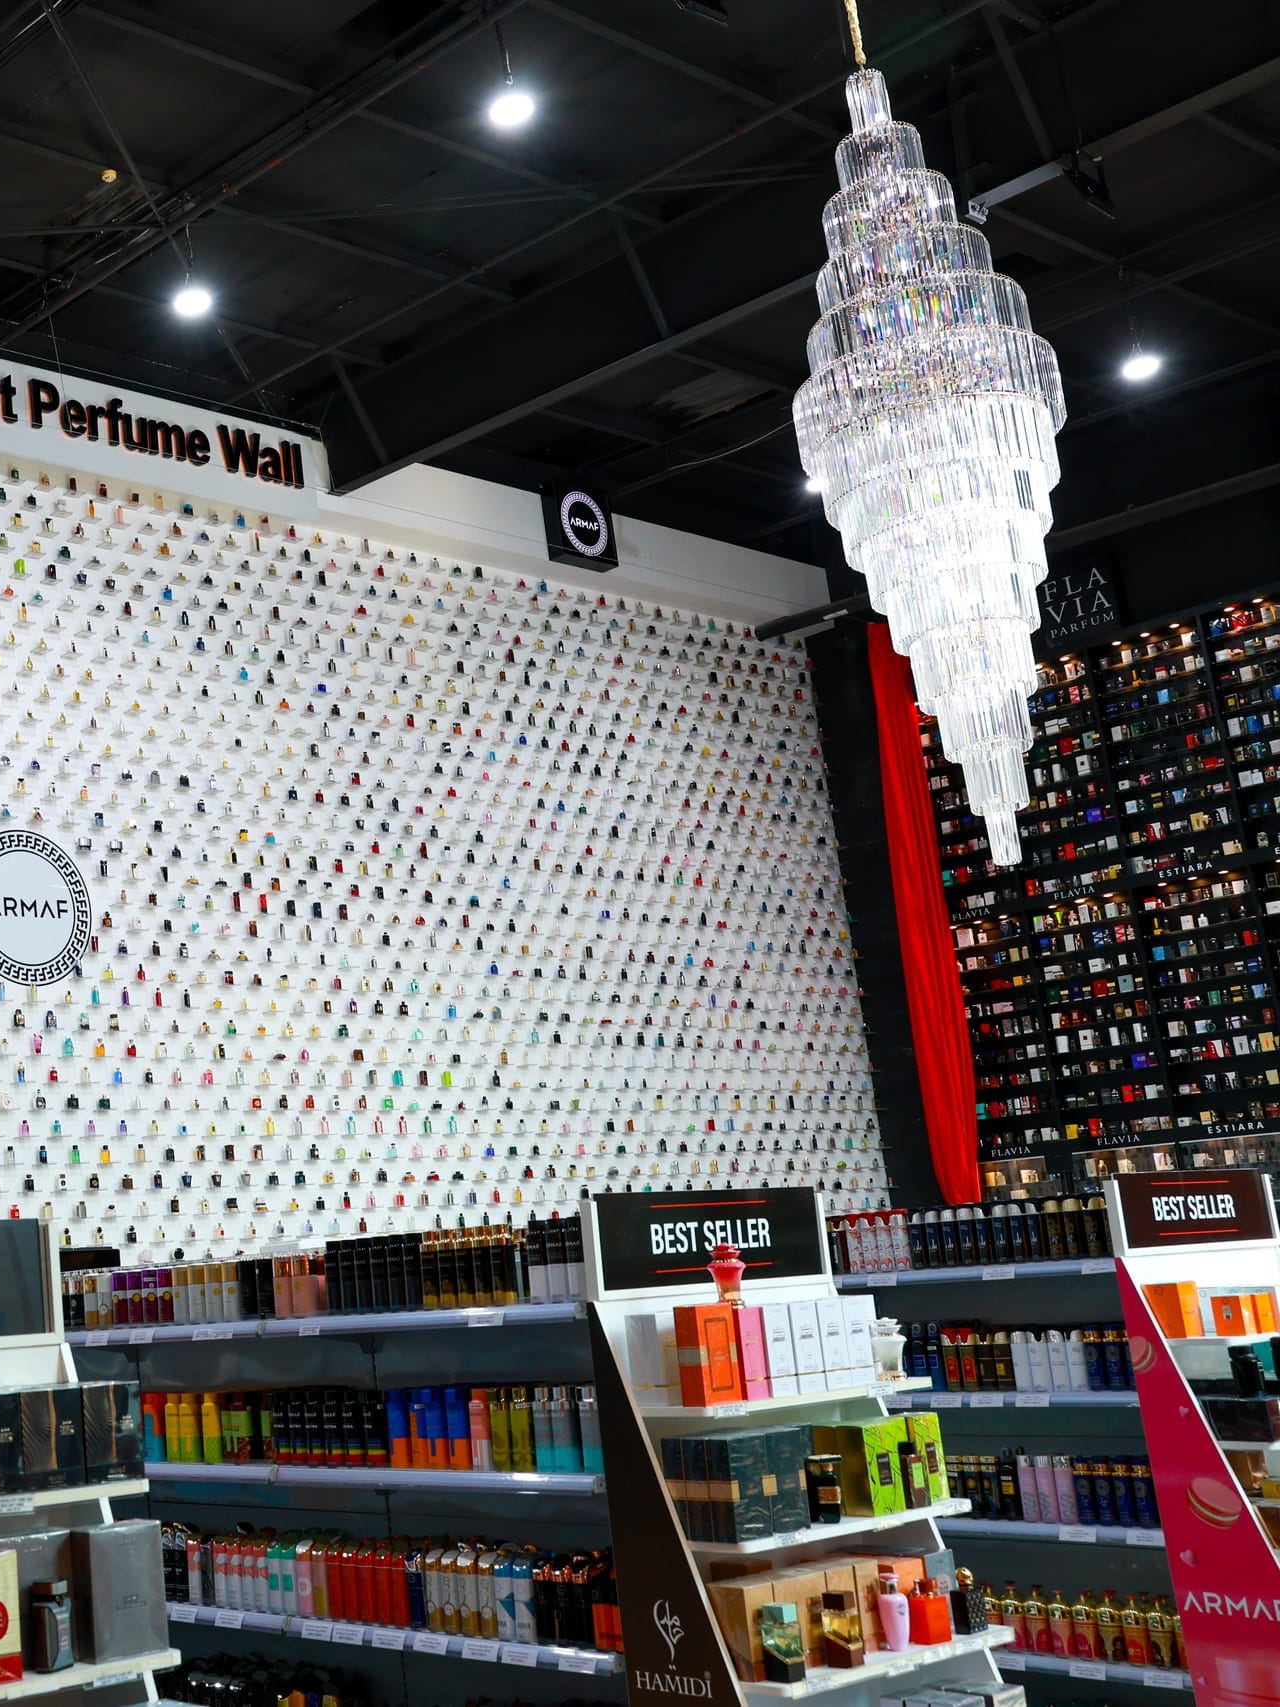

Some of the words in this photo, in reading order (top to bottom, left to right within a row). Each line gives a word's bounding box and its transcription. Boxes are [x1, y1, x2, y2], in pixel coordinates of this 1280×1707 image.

[26, 378, 211, 467] Perfume
[216, 423, 304, 489] Wall
[570, 517, 599, 531] ARMAF
[1041, 567, 1108, 604] FLA
[1045, 590, 1112, 624] VIA
[1050, 611, 1115, 639] PARFUM
[1158, 861, 1213, 879] ESTIARA
[1054, 885, 1096, 901] FLAVIA
[952, 907, 990, 921] FLAVIA
[1207, 1121, 1265, 1134] ESTIARA
[1097, 1134, 1141, 1146] FLAVIA
[991, 1146, 1031, 1158] FLAVIA
[1151, 1196, 1186, 1221] BEST
[1187, 1194, 1236, 1219] SELLER
[650, 1222, 699, 1254] BEST
[703, 1218, 771, 1252] SELLER
